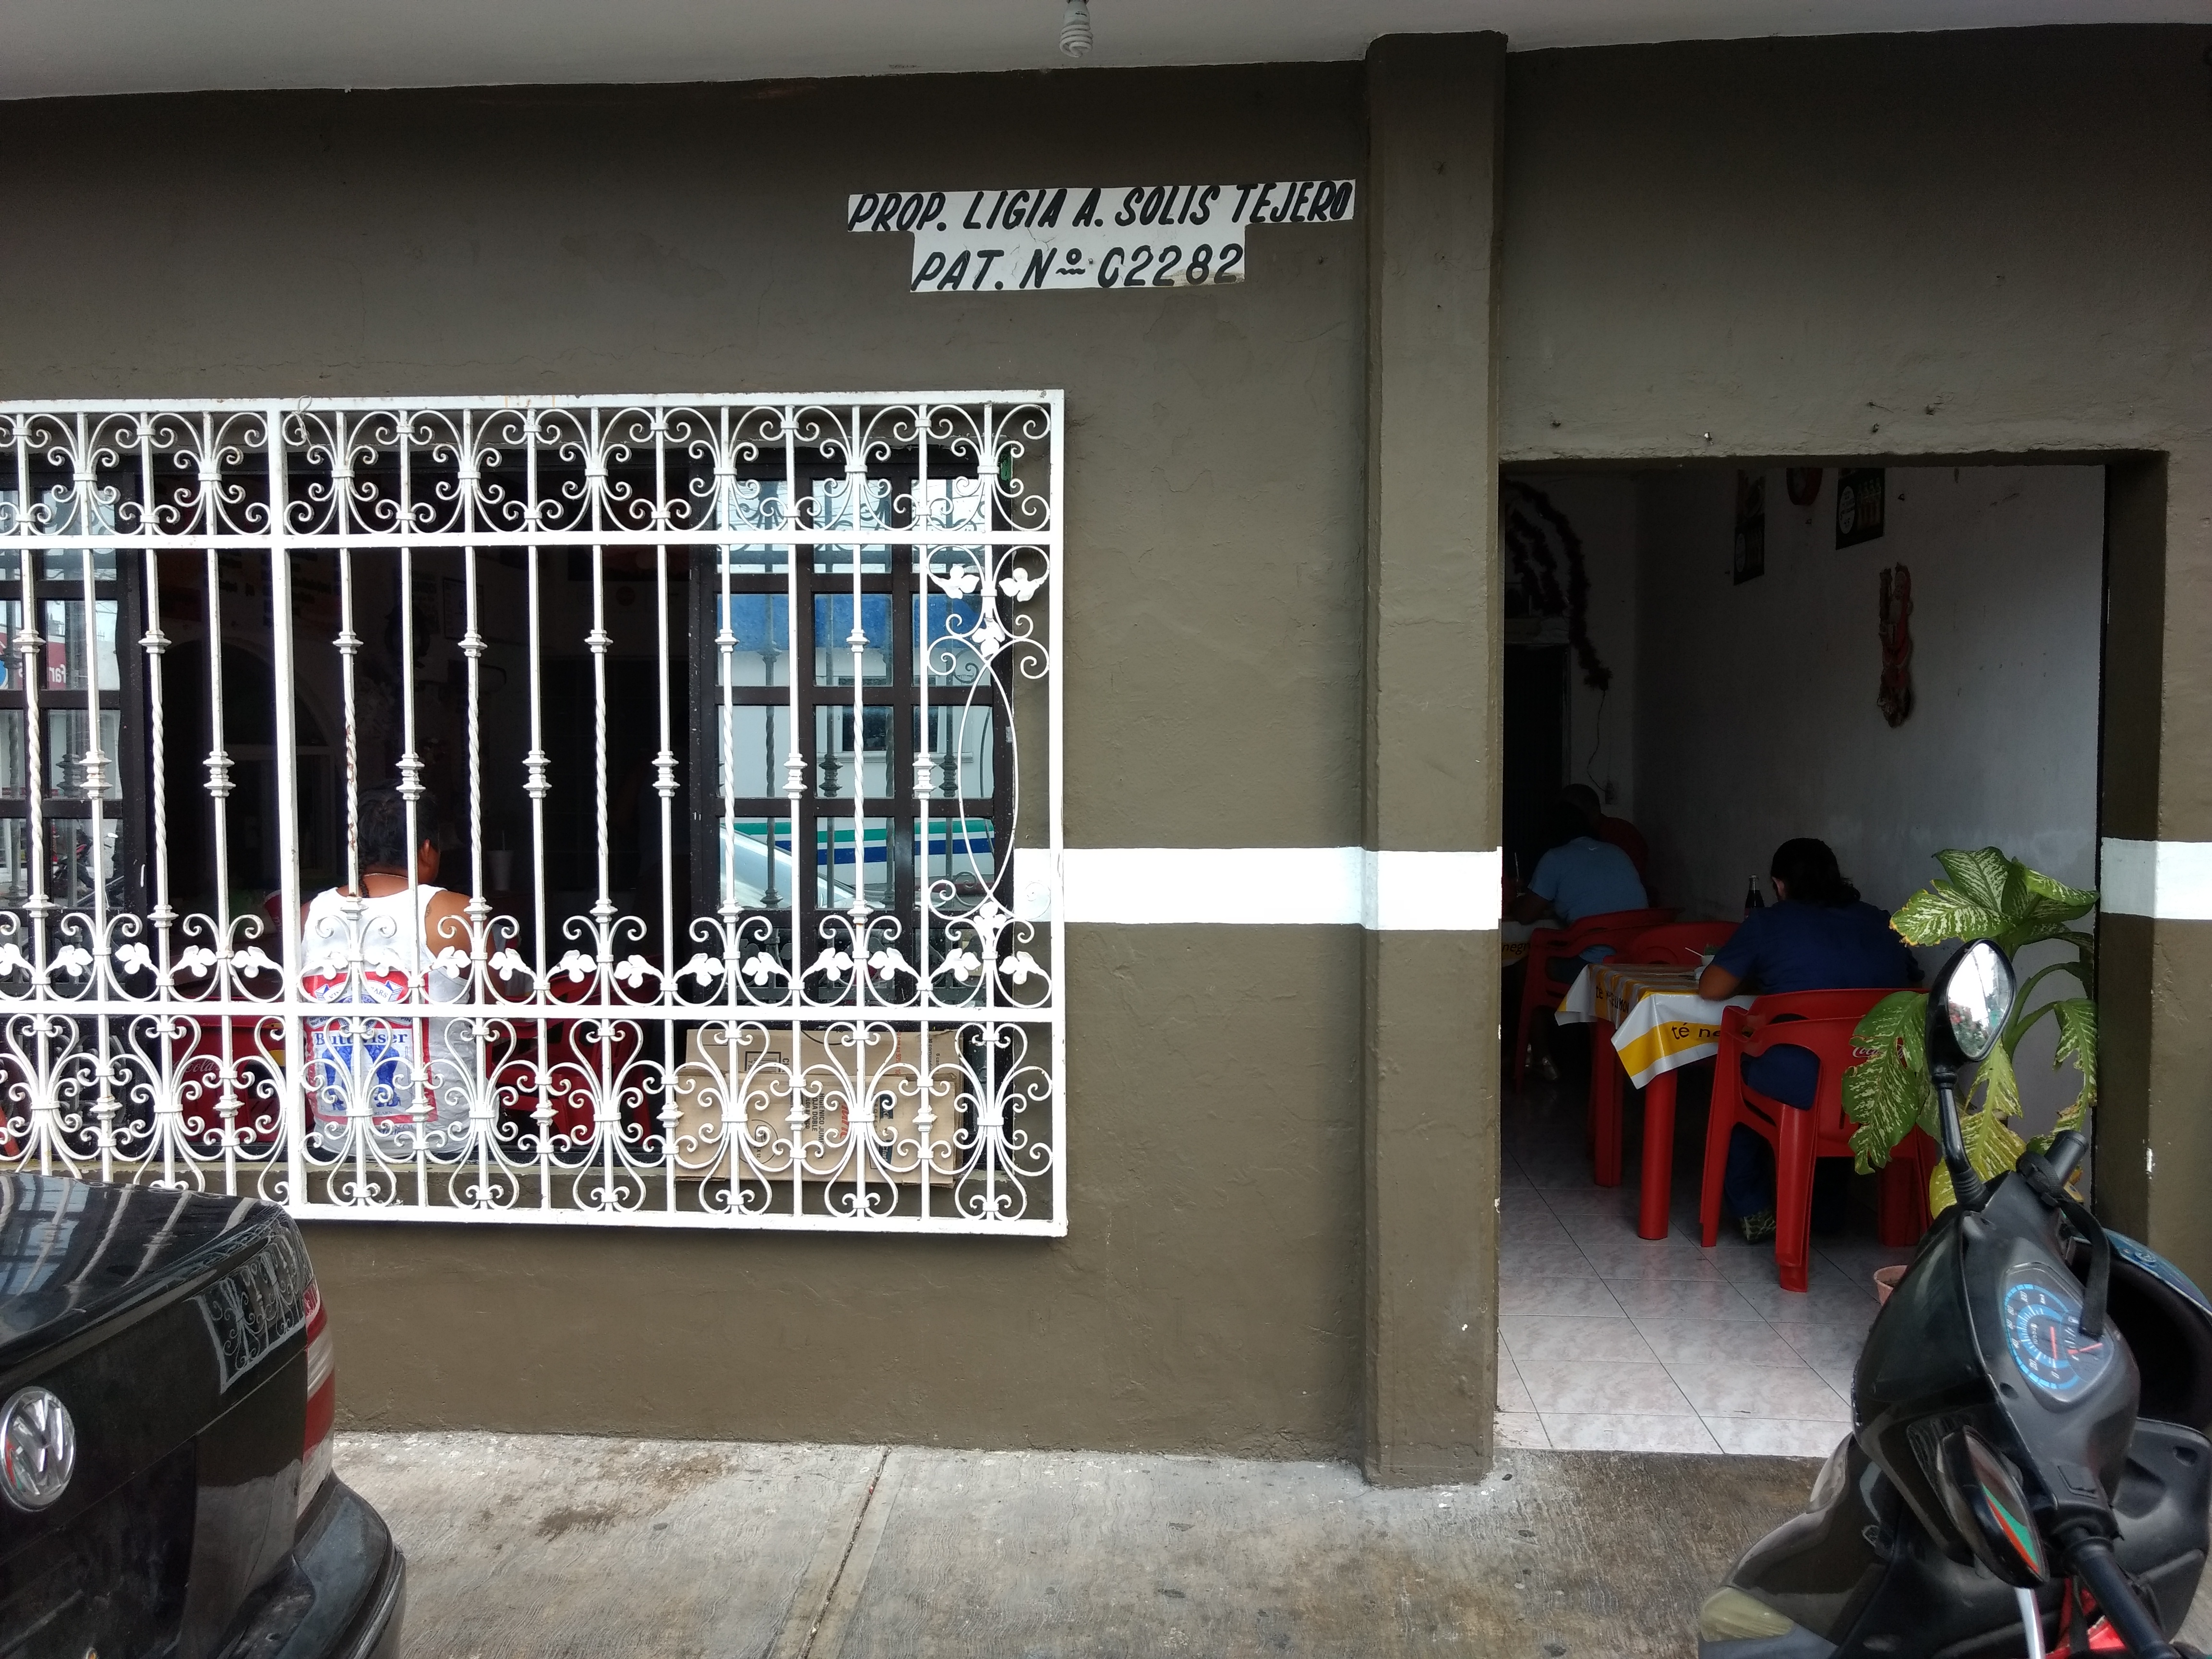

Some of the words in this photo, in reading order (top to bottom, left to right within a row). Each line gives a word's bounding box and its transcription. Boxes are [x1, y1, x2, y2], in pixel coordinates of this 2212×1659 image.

[848, 192, 947, 231] PROP.
[963, 189, 1068, 230] LIGIA
[1072, 188, 1103, 227] A.
[1115, 185, 1221, 227] SOLIS
[1232, 181, 1353, 223] TEJERO
[911, 250, 1004, 291] PAT.
[1671, 1022, 1690, 1040] té
[1698, 1029, 1721, 1038] ne
[2029, 1358, 2038, 1371] 20
[2051, 1370, 2060, 1379] 0
